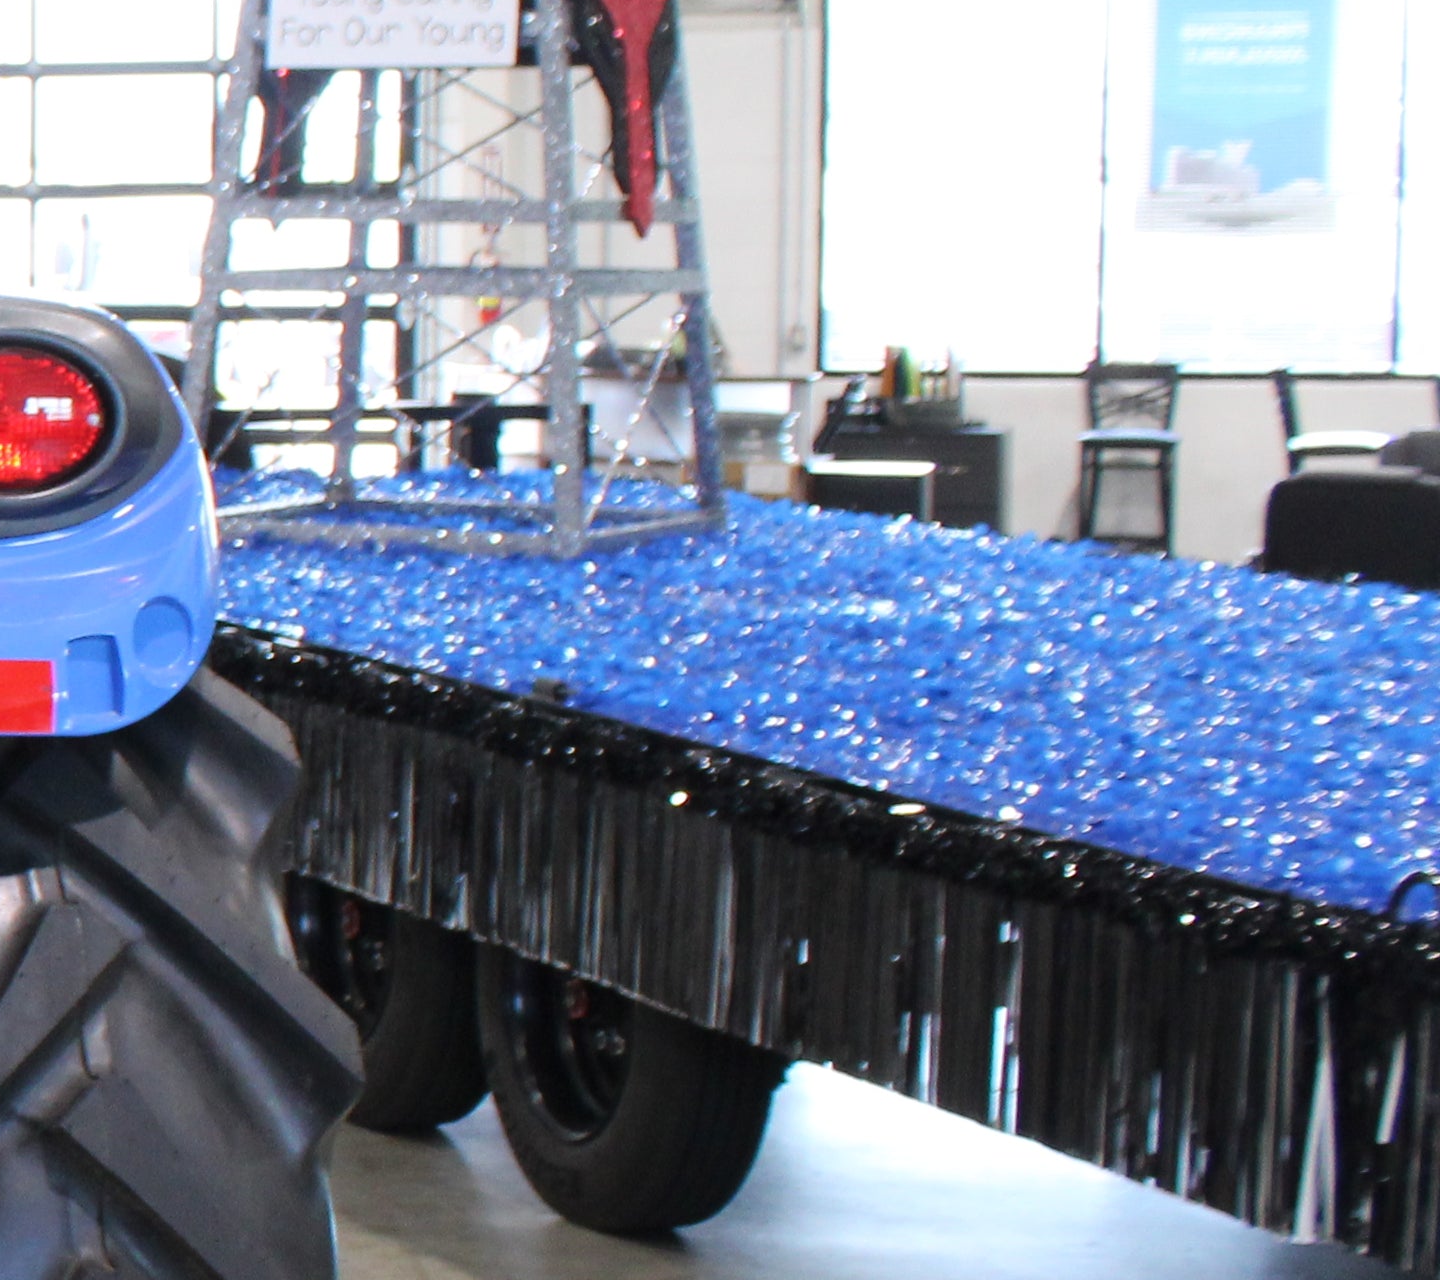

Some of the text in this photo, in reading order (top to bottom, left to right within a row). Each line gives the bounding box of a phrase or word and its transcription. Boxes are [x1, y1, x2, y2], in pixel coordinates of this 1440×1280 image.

[281, 17, 505, 53] For Our Young
